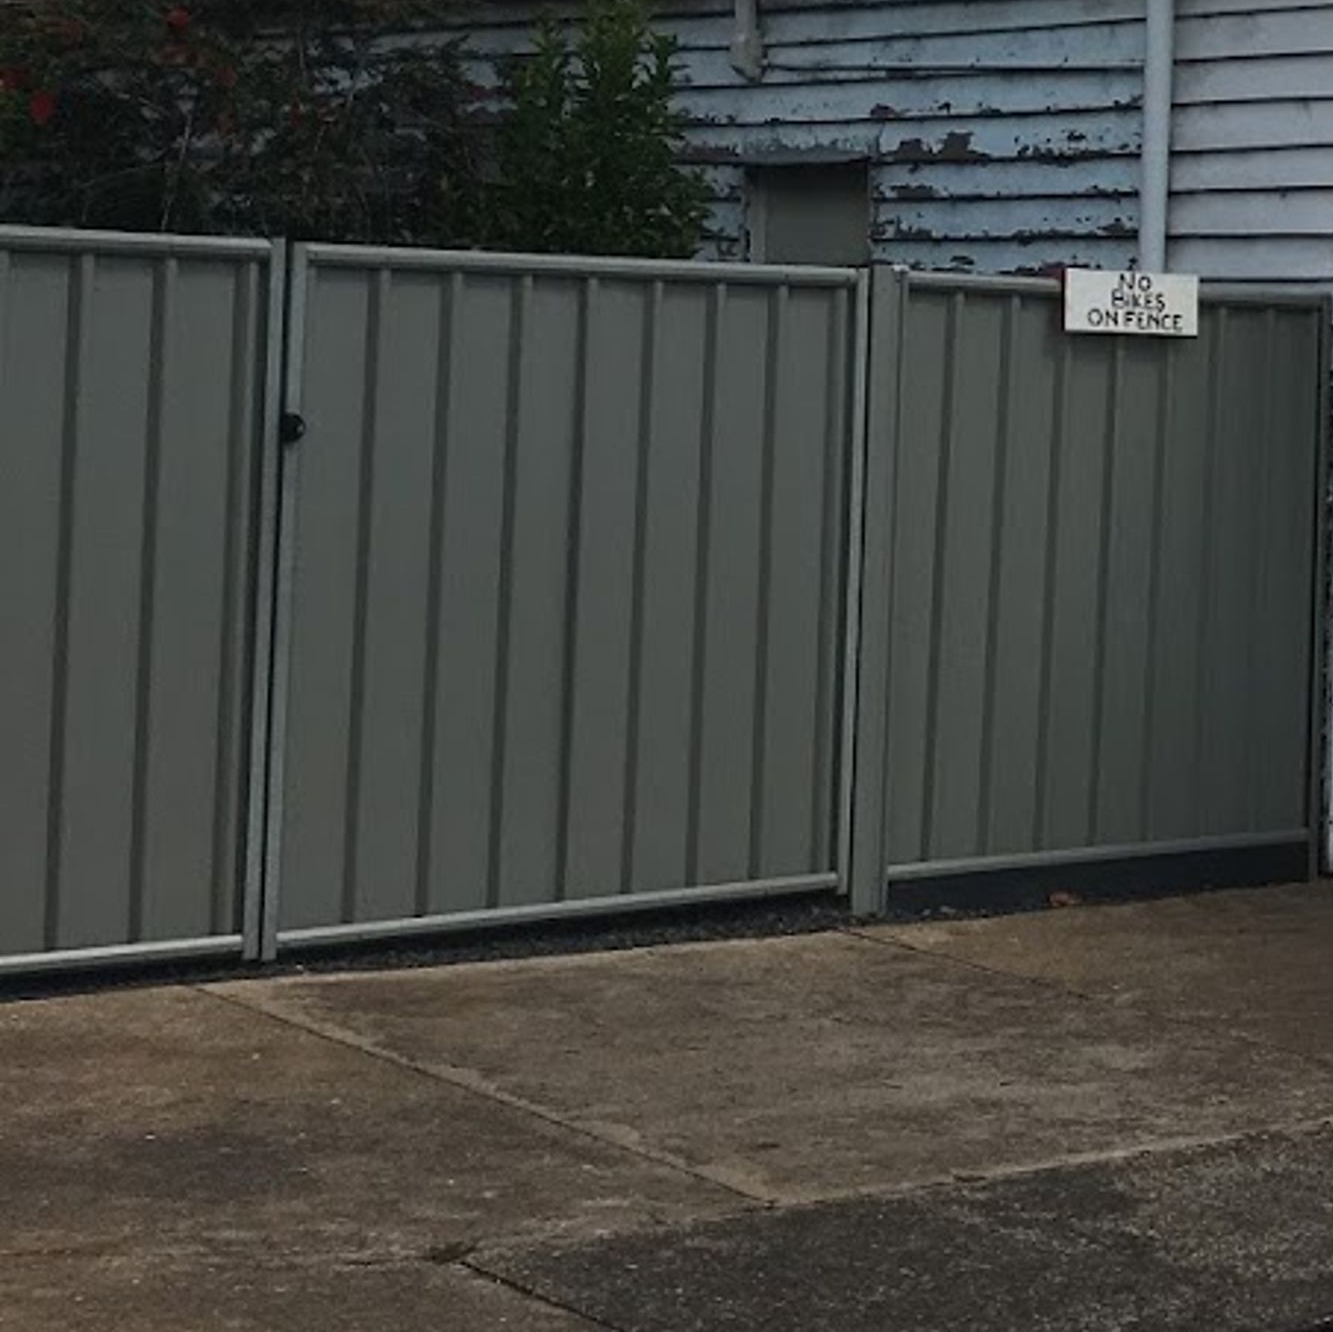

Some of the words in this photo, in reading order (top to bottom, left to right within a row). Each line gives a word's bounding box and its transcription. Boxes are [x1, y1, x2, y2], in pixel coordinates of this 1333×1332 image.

[1118, 272, 1152, 292] NO
[1111, 288, 1166, 313] BIKES
[1087, 308, 1119, 327] ON
[1123, 311, 1184, 333] FENCE
